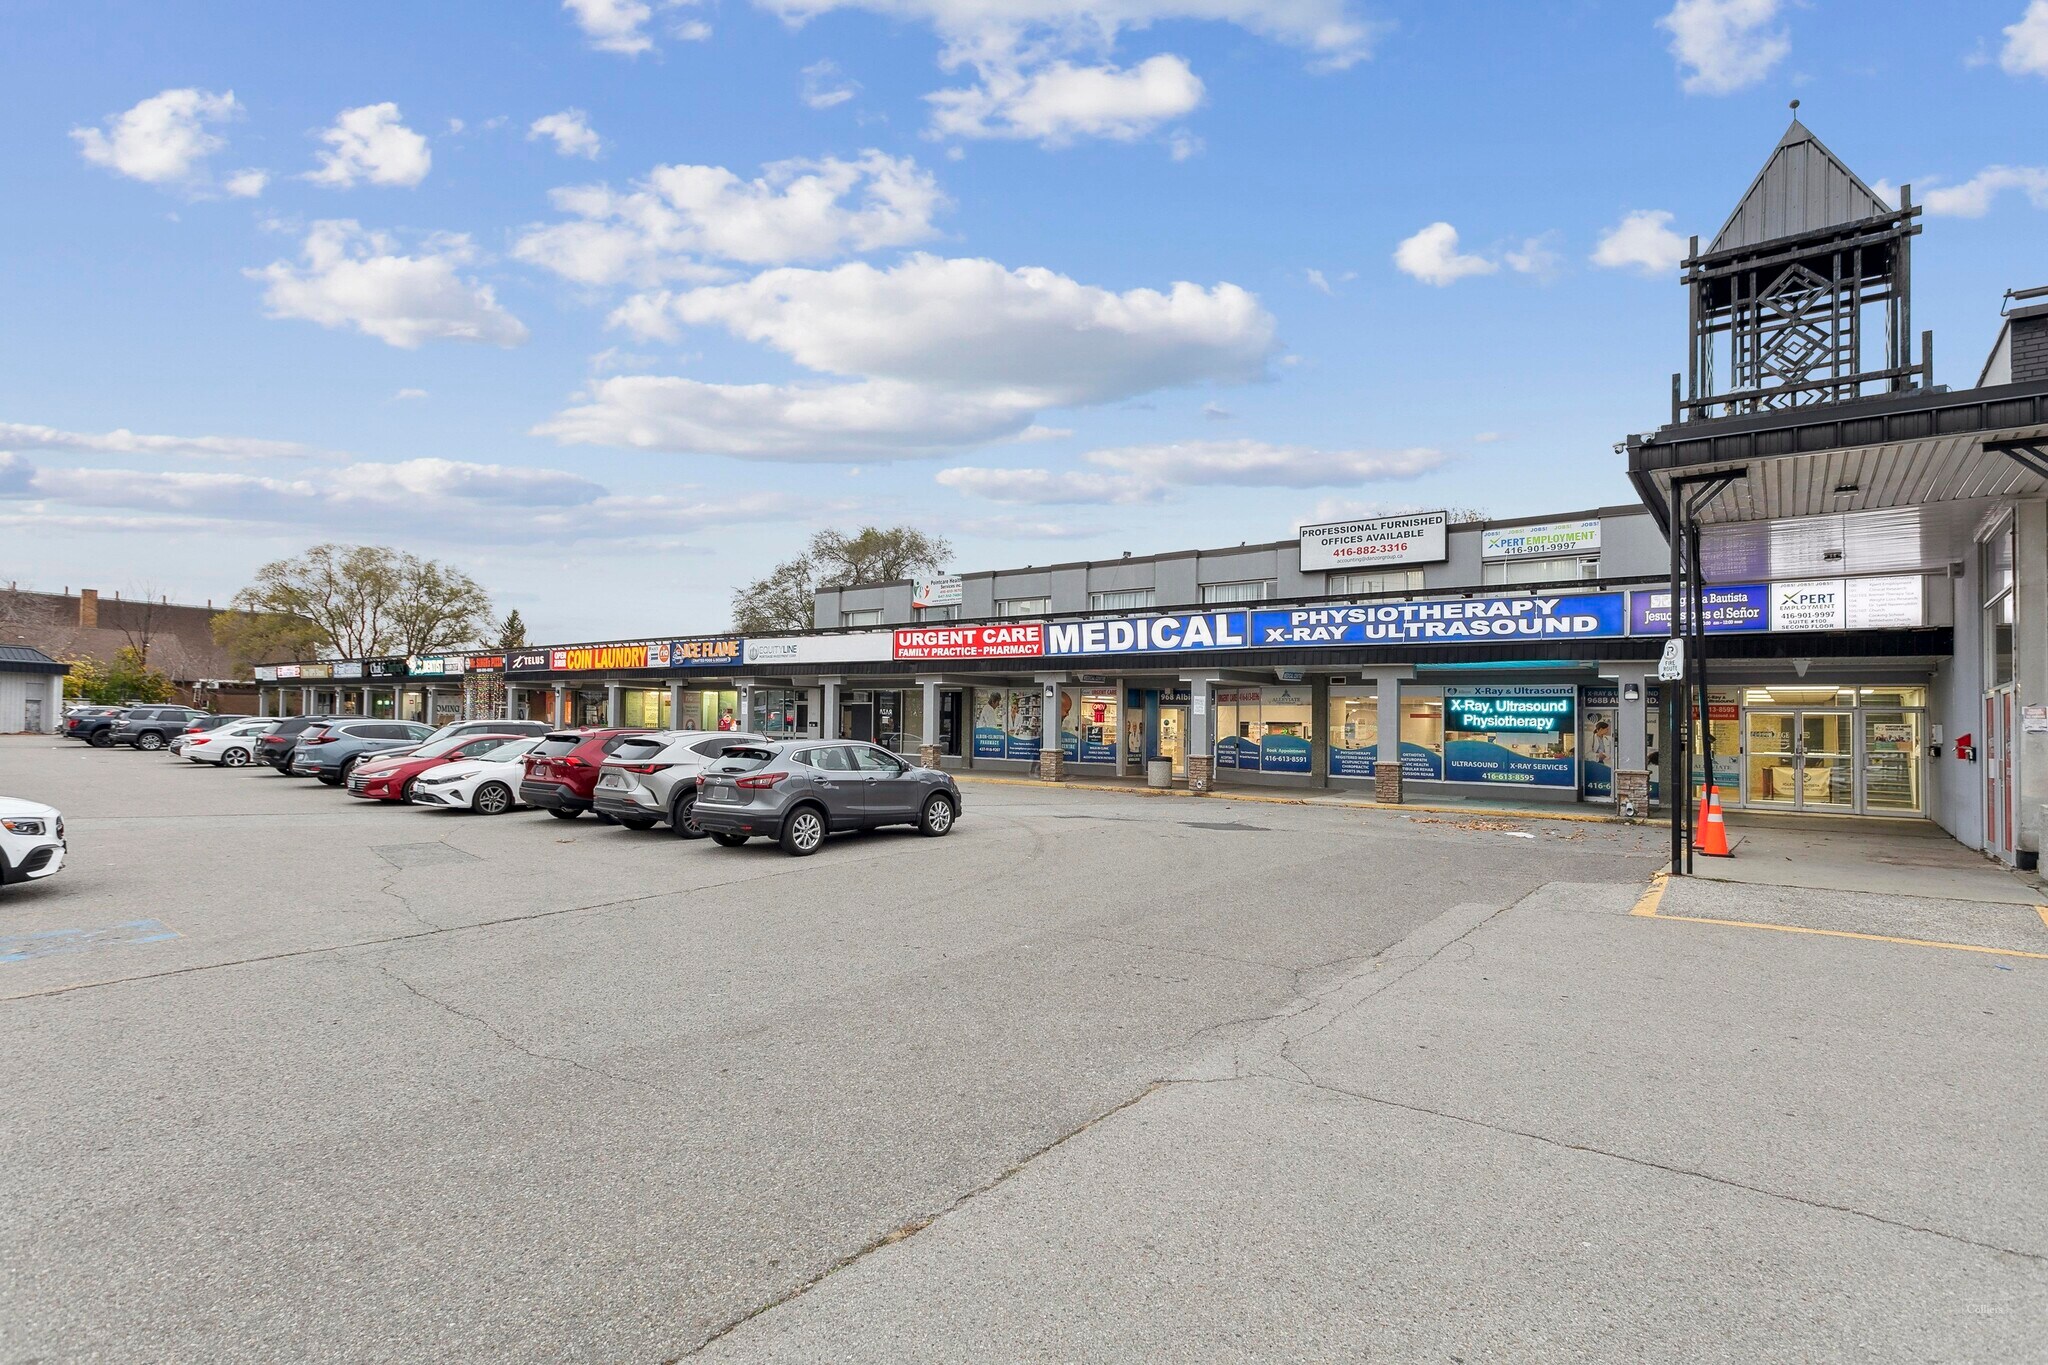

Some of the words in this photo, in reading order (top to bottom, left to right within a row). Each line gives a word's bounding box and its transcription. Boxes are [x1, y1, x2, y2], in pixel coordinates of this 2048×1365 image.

[1302, 523, 1377, 537] PROFESSIONAL
[1381, 516, 1443, 530] FURNISHED
[1322, 535, 1363, 546] OFFICES
[1366, 529, 1424, 542] AVAILABLE
[1488, 536, 1525, 548] XPERT
[1526, 531, 1595, 545] EMPLOYMENT
[1333, 542, 1408, 557] 416-882-3316
[1505, 542, 1576, 554] 416-901-9997
[1710, 593, 1748, 604] Bautista
[1781, 588, 1835, 605] XPERT
[1291, 599, 1560, 626] PHYSIOTHERAPY
[1713, 608, 1724, 619] el
[1726, 606, 1759, 618] Señor
[1781, 611, 1835, 619] 416-901-9997
[898, 630, 977, 646] URGENT
[982, 626, 1040, 643] CARE
[1050, 614, 1243, 654] MEDICAL
[1265, 625, 1349, 643] X-RAY
[1365, 616, 1598, 639] ULTRASOUND
[683, 643, 702, 658] ICE
[702, 640, 740, 657] FLAME
[898, 647, 930, 657] FAMILY
[524, 655, 545, 666] TELUS
[567, 649, 593, 669] COIN
[595, 647, 648, 668] LAUNDRY
[1474, 688, 1503, 696] X-Ray
[1451, 700, 1493, 714] X-Ray,
[1496, 700, 1567, 712] Ultrasound
[1464, 715, 1554, 730] Physiotherapy
[1451, 760, 1499, 769] ULTRASOUND
[1509, 762, 1532, 770] X-RAY
[1533, 763, 1568, 771] SERVICES
[1481, 772, 1535, 781] 416-613-8595
